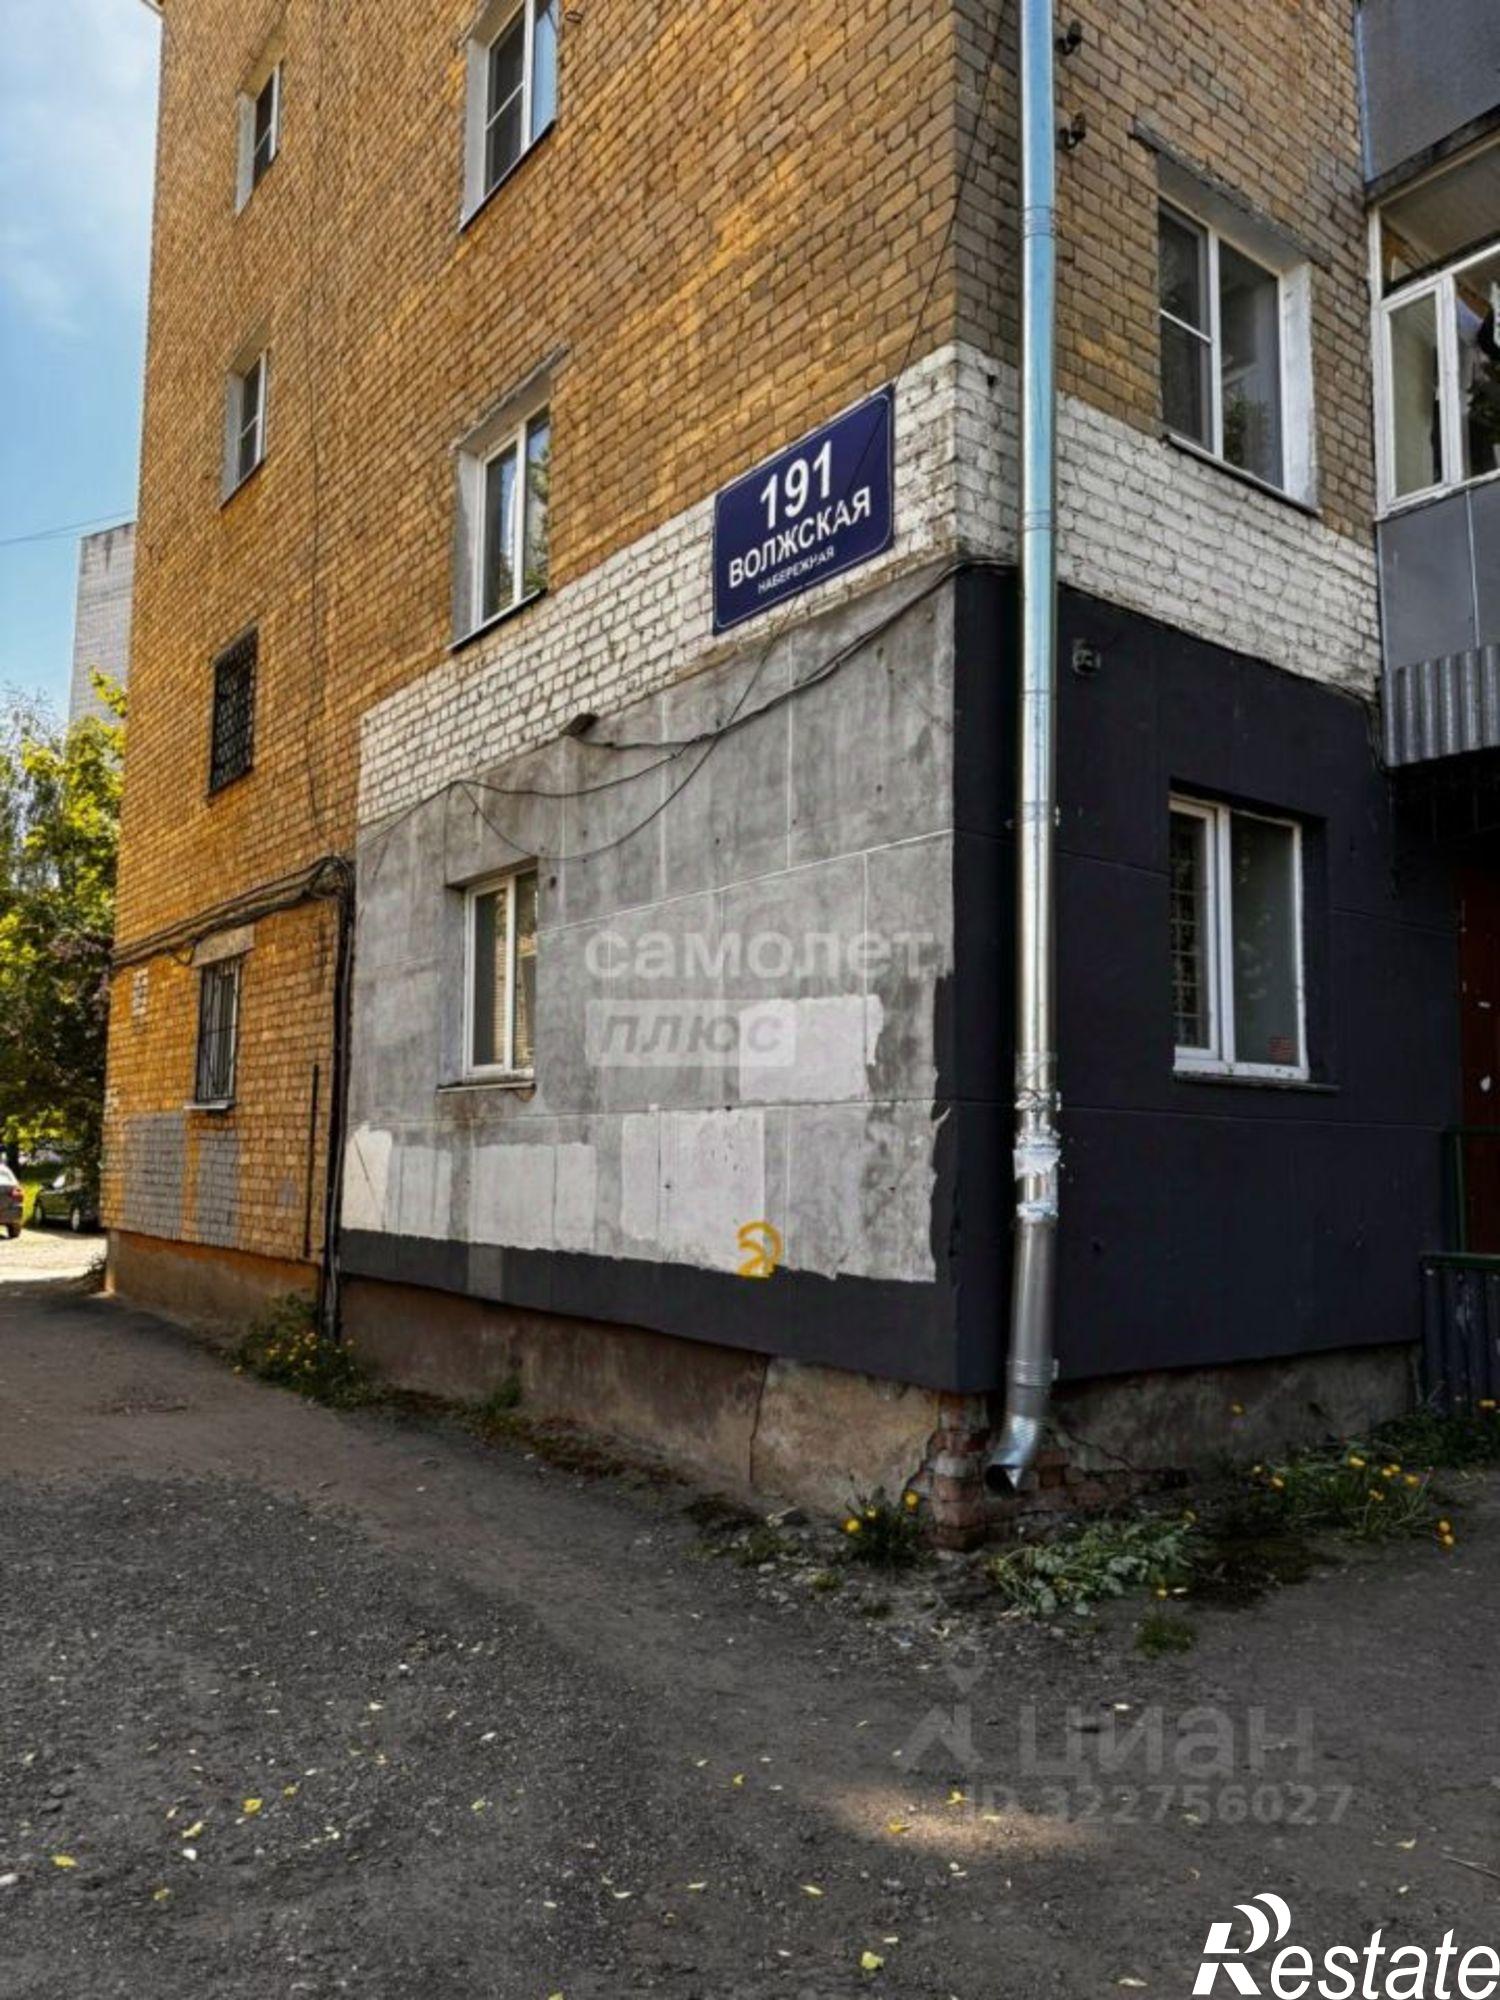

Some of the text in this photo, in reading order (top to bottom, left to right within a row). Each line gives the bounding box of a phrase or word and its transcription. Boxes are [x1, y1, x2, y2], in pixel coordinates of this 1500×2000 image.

[760, 440, 832, 530] 191
[728, 486, 871, 589] ВОЛЖСКАЯ
[757, 546, 835, 594] НАБЕРЕЖНАЯ
